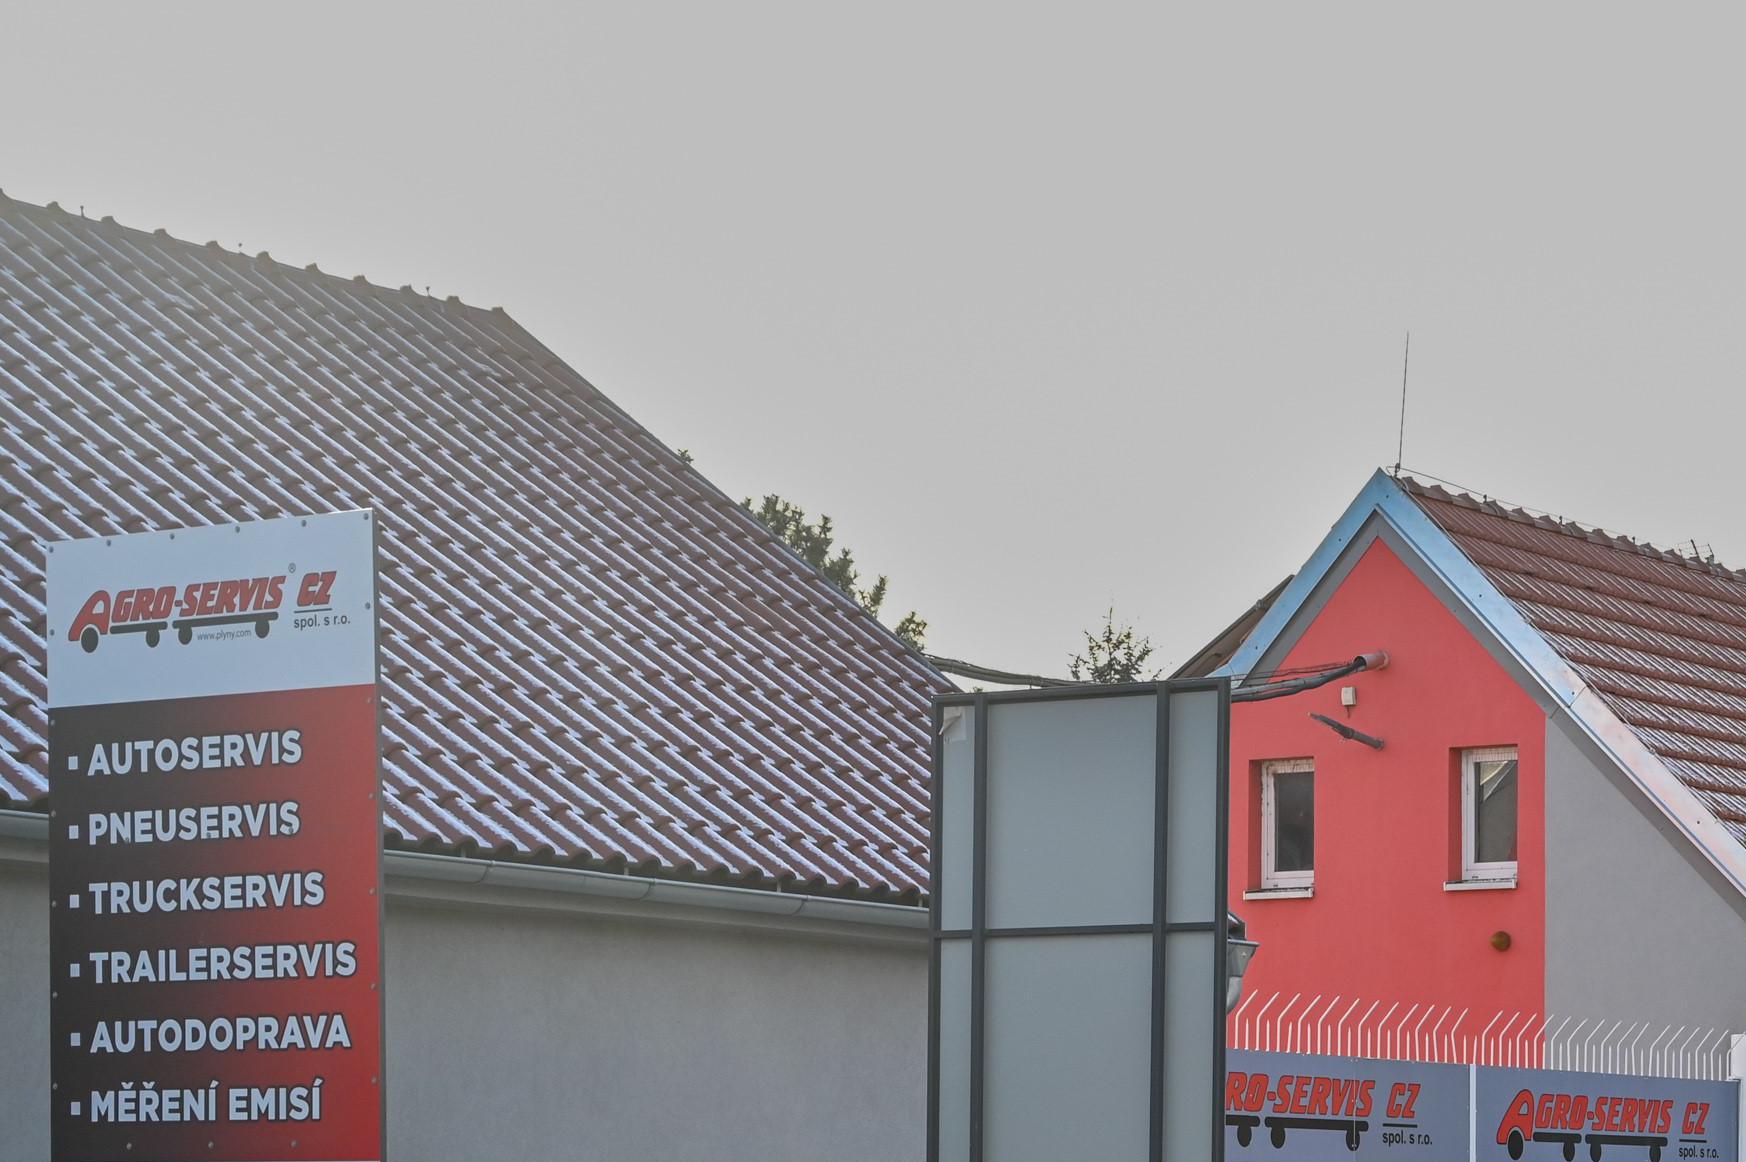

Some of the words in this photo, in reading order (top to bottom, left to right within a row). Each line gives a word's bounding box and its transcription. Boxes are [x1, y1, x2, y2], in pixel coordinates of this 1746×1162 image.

[68, 575, 287, 642] AGRO-SERVIS
[296, 570, 337, 607] CZ
[293, 615, 321, 631] spol.
[324, 616, 331, 626] s
[333, 613, 351, 625] r.o.
[197, 628, 252, 642] www.plyny.com
[87, 729, 303, 776] AUTOSERVIS
[88, 801, 301, 846] PNEUSERVIS
[88, 871, 325, 915] TRUCKSERVIS
[89, 941, 357, 984] TRAILERSERVIS
[89, 1013, 352, 1054] AUTODOPRAVA
[90, 1079, 220, 1123] MĚŘENÍ
[228, 1077, 325, 1121] EMISÍ
[1386, 1082, 1421, 1119] CZ
[1496, 1088, 1674, 1146] AGRO-SERVIS
[1681, 1102, 1711, 1135] CZ
[1382, 1130, 1407, 1147] spol.
[1409, 1135, 1415, 1145] s
[1417, 1133, 1433, 1145] r.o.
[1678, 1146, 1698, 1160] spol.
[1699, 1150, 1705, 1159] s
[1706, 1148, 1720, 1160] r.o.
